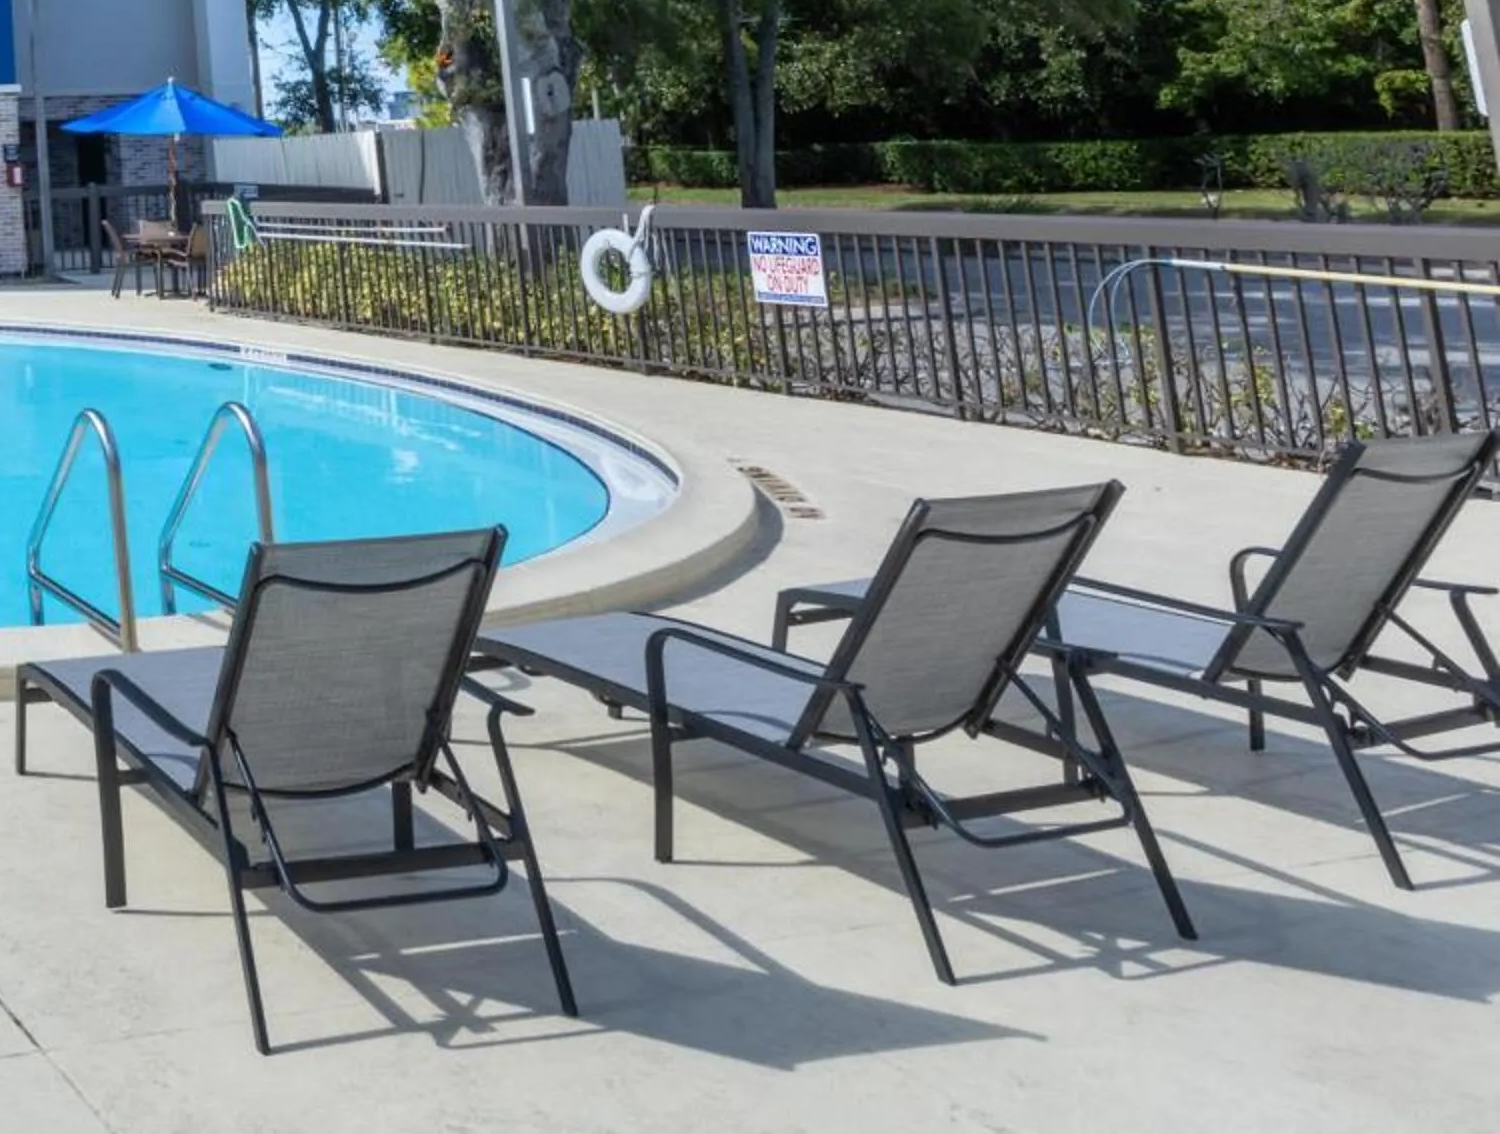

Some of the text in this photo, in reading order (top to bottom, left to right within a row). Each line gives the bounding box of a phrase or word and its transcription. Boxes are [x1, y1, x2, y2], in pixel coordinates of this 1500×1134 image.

[751, 237, 817, 255] WARNING
[753, 256, 819, 275] NO LIFEGUARD
[767, 274, 808, 293] ON DUTY
